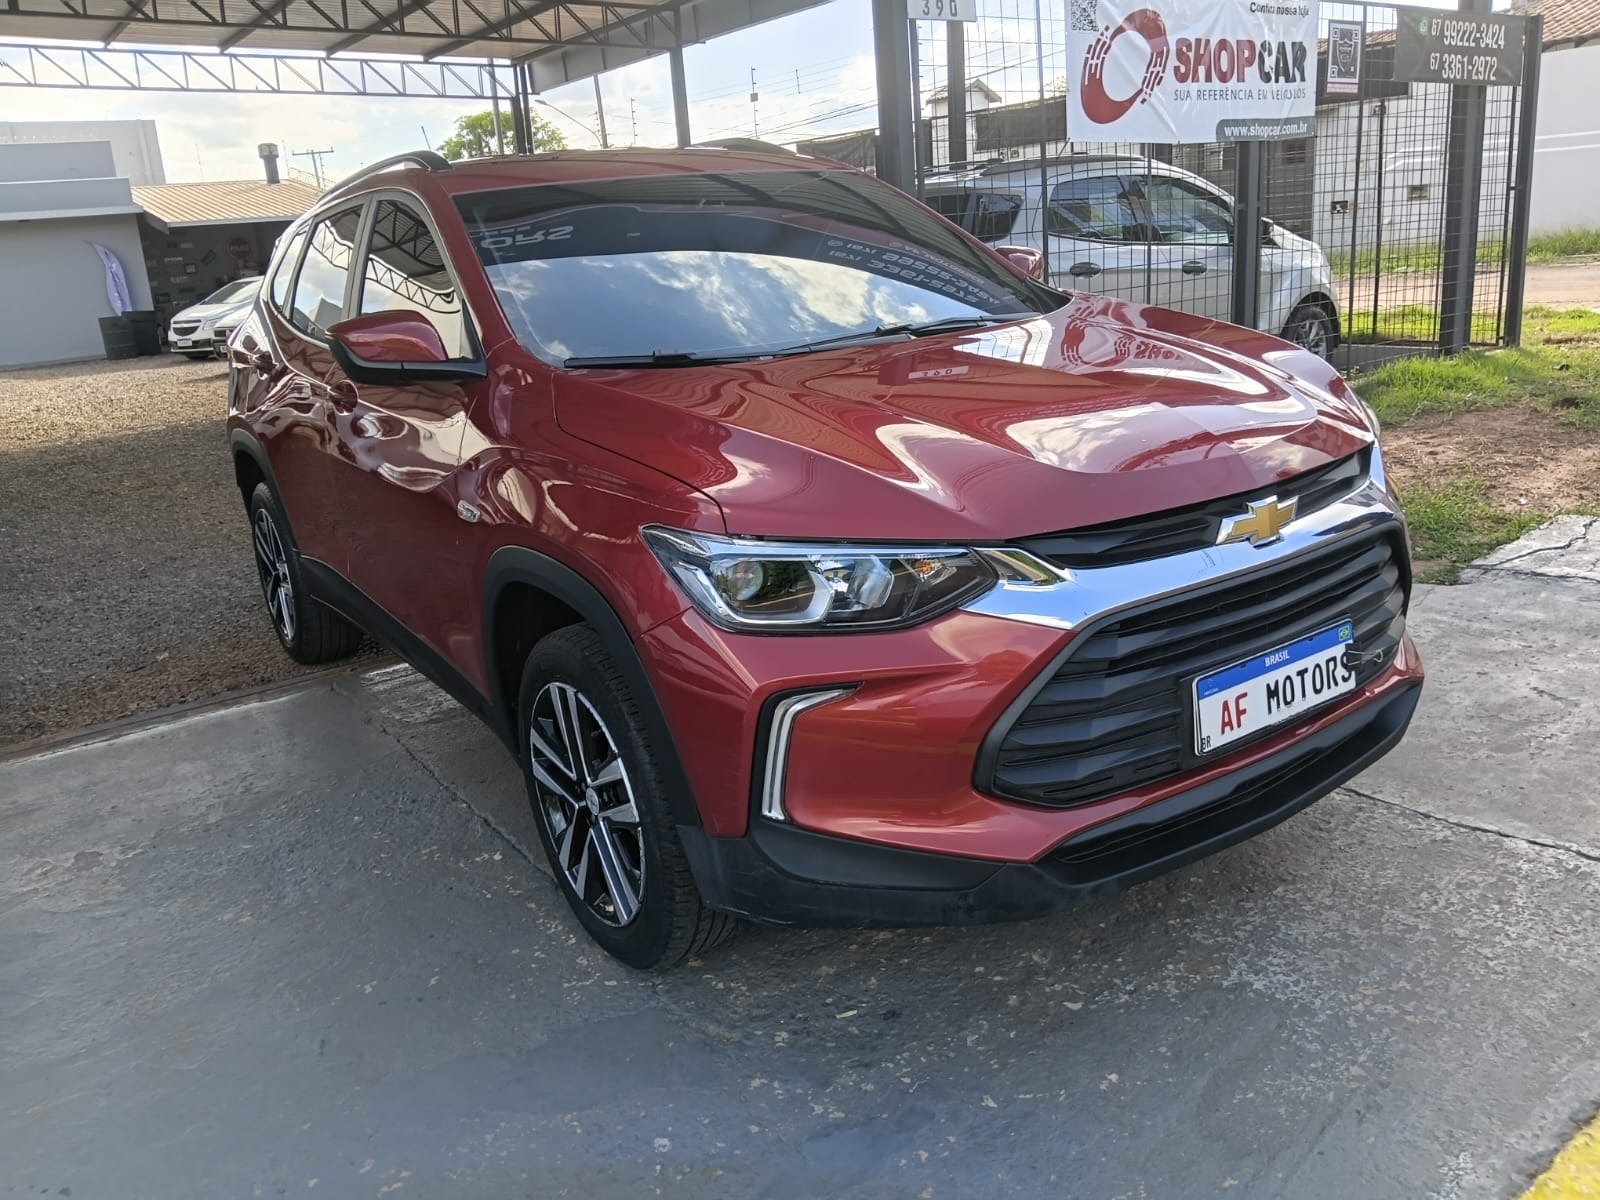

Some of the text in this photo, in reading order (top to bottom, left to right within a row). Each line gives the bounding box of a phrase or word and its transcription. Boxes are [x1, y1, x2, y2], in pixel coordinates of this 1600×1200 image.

[922, 0, 957, 17] 390
[1276, 6, 1298, 16] nossa
[1431, 18, 1505, 49] 67 99222-3424
[1173, 38, 1307, 84] SHOPCAR
[1430, 52, 1498, 81] 67 3361-2972
[1174, 89, 1192, 101] SUA
[1196, 87, 1254, 101] REFERÊNCIA
[1224, 121, 1308, 138] www.shopcar.com.br
[1265, 650, 1290, 667] BRASIL
[1220, 652, 1352, 735] AF MOTORS
[1201, 735, 1211, 750] BR
